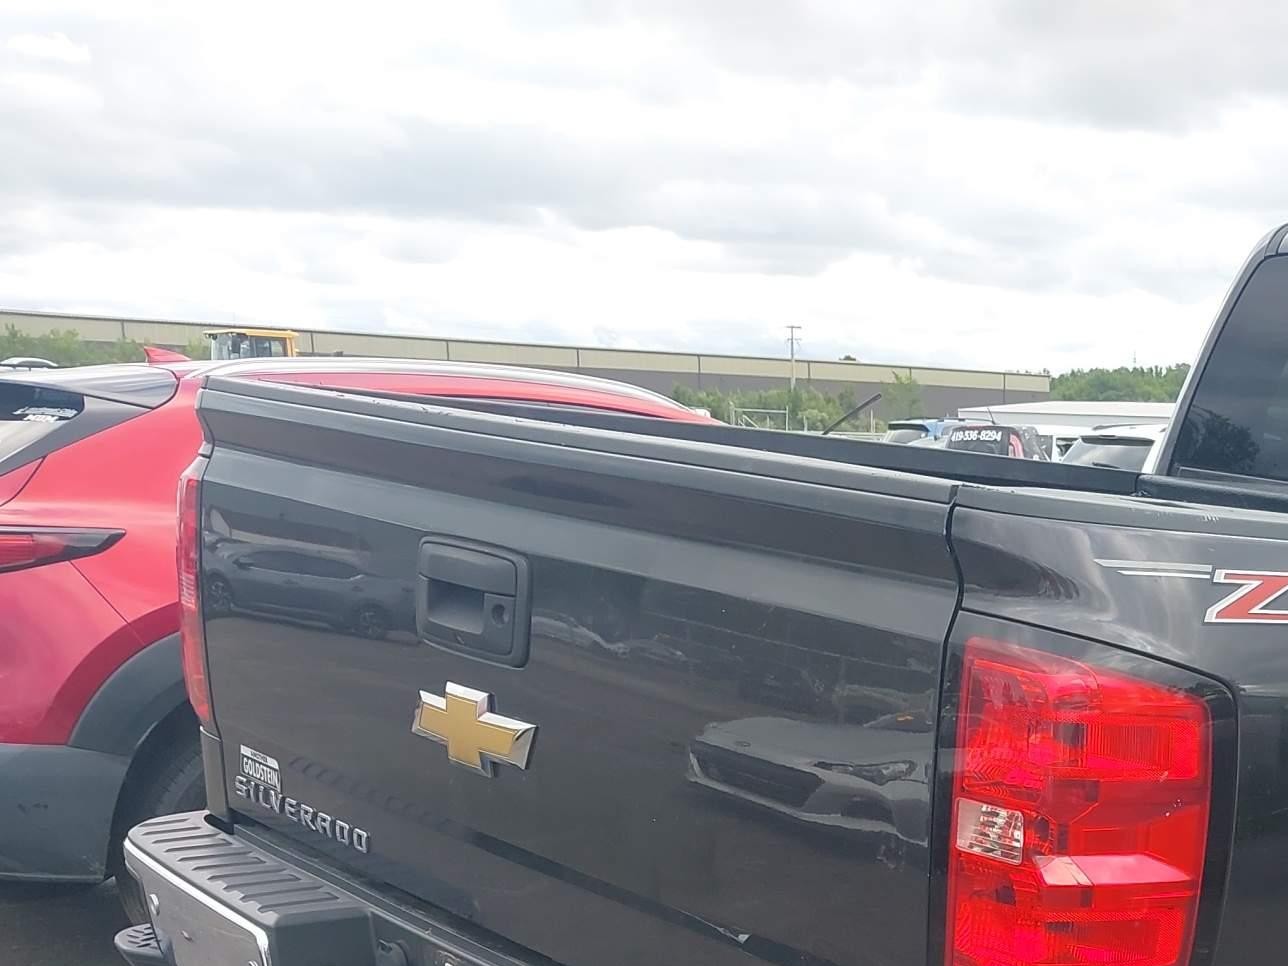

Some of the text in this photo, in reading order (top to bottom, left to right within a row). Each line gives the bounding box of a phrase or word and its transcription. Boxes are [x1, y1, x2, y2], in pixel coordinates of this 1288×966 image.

[951, 430, 1002, 441] 419-536-8294
[243, 757, 279, 789] GOLDSTEIN
[235, 775, 369, 853] SILVERADO
